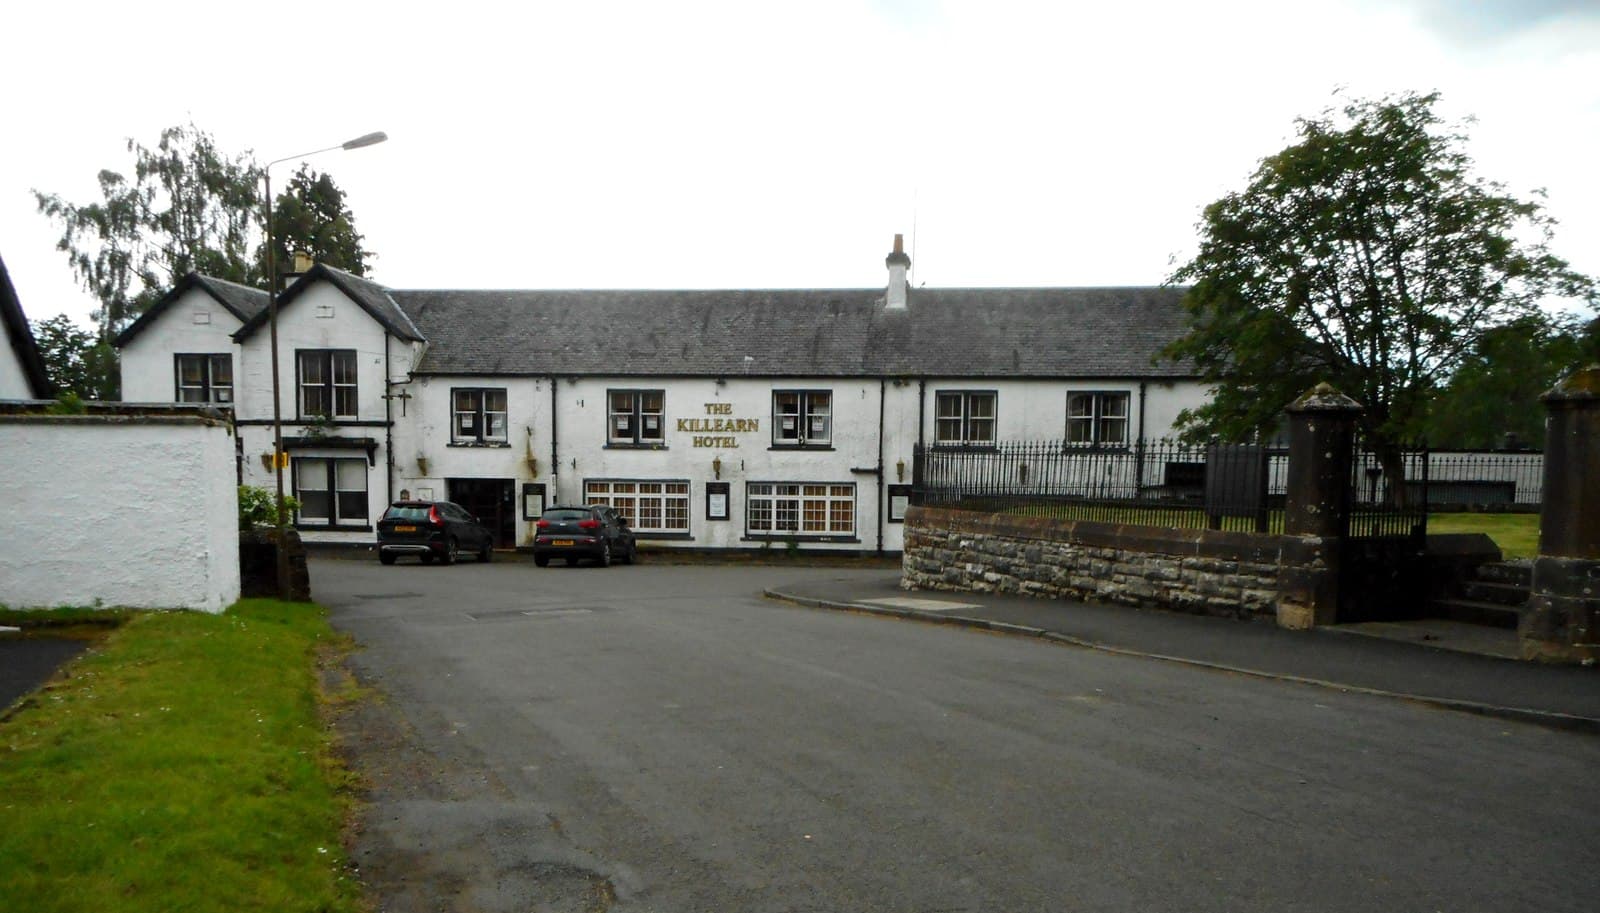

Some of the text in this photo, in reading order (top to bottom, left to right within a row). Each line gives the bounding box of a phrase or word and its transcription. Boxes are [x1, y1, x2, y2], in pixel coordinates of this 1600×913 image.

[704, 403, 732, 415] THE
[676, 418, 759, 432] KILLEARN
[692, 436, 739, 448] HOTEL
